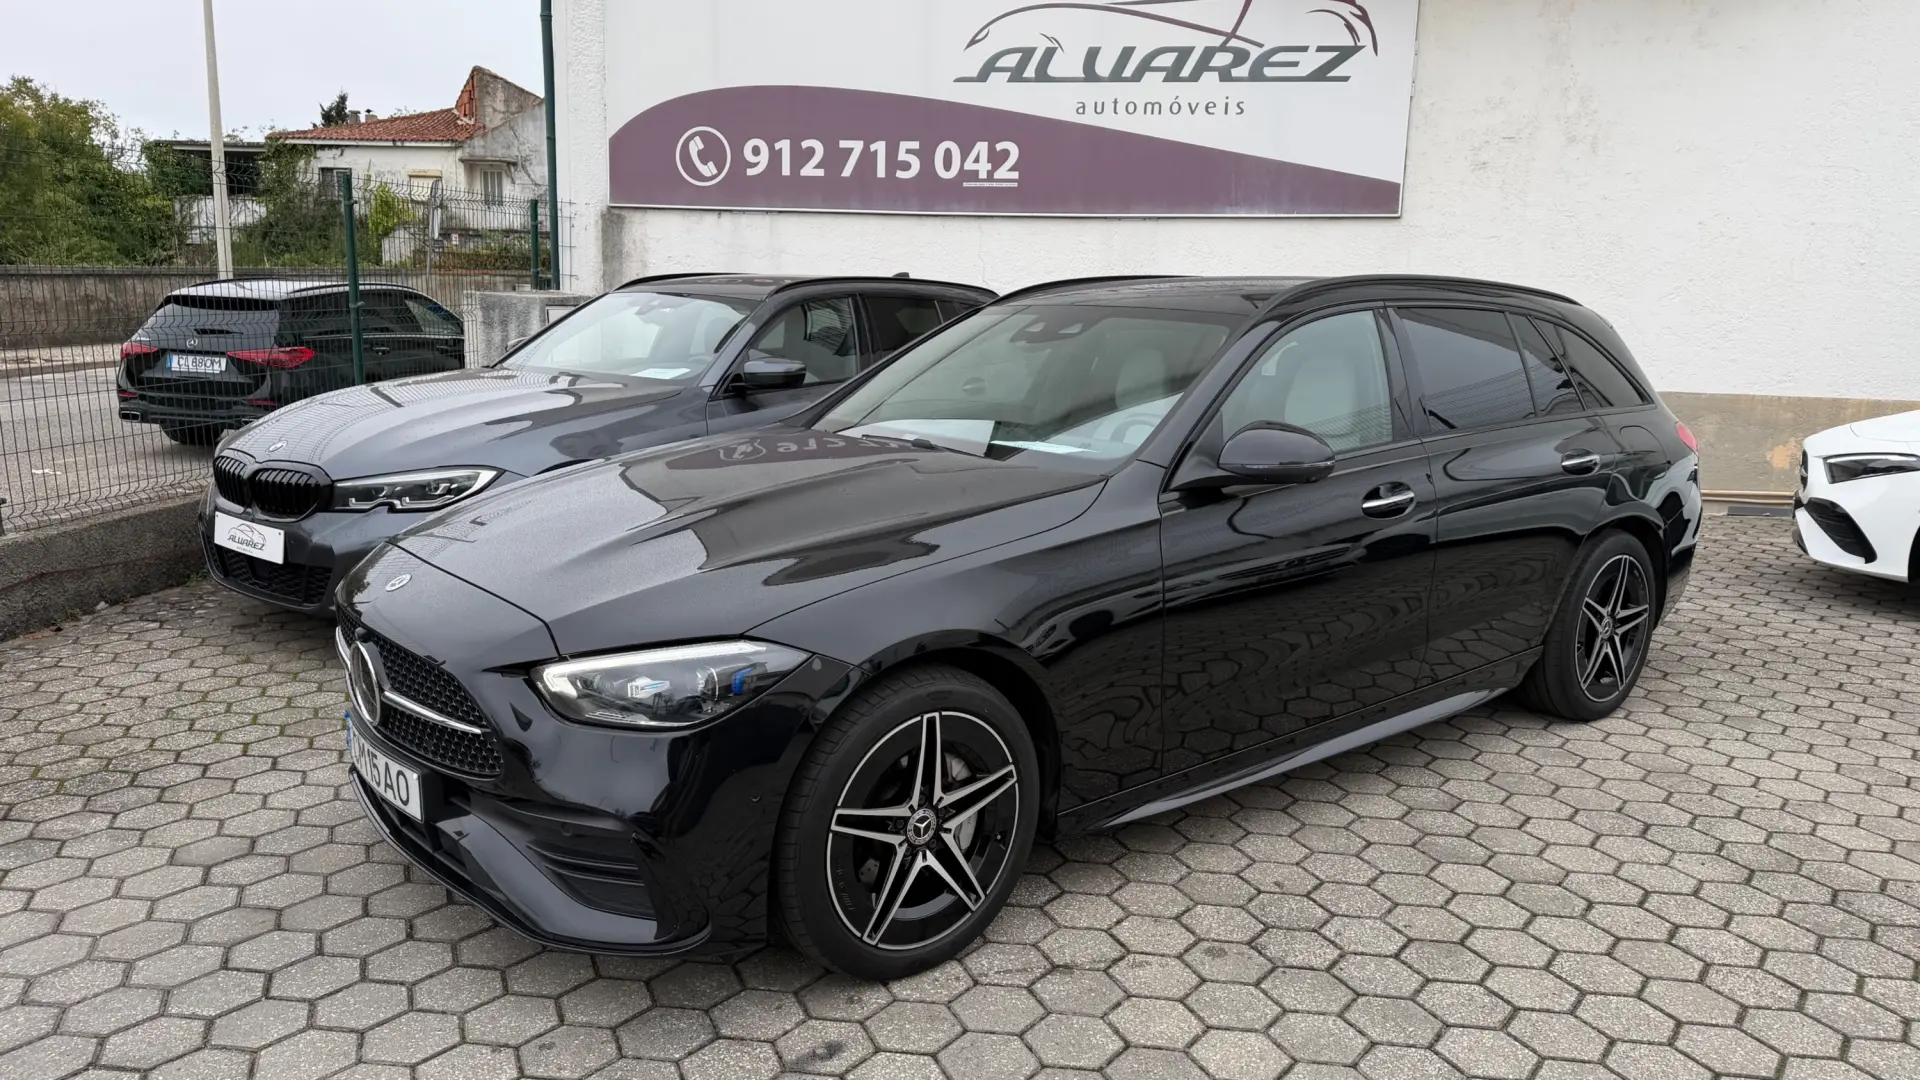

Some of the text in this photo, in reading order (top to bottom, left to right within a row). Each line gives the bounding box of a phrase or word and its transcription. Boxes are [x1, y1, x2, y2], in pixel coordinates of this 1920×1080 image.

[952, 45, 1367, 83] ALVAREZ
[1075, 96, 1246, 116] automóveis
[743, 138, 1020, 180] 912 715 042
